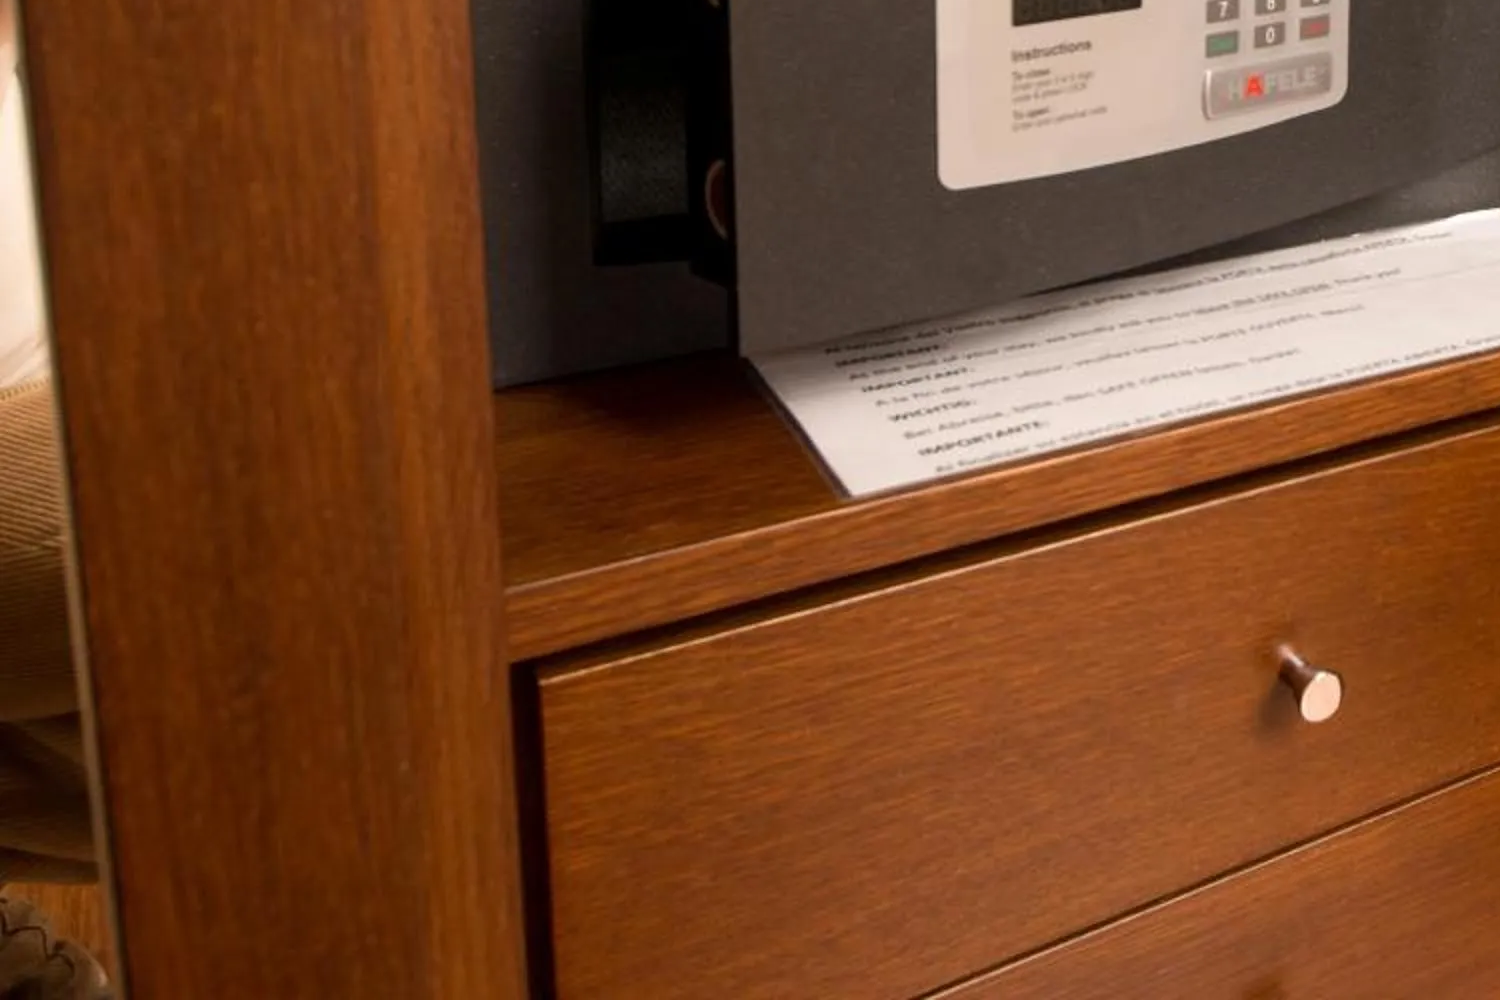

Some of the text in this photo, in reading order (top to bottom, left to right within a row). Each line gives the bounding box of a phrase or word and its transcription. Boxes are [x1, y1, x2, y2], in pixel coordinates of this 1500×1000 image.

[1218, 1, 1228, 18] 7
[1266, 27, 1274, 43] 0
[1012, 41, 1092, 62] Instructions
